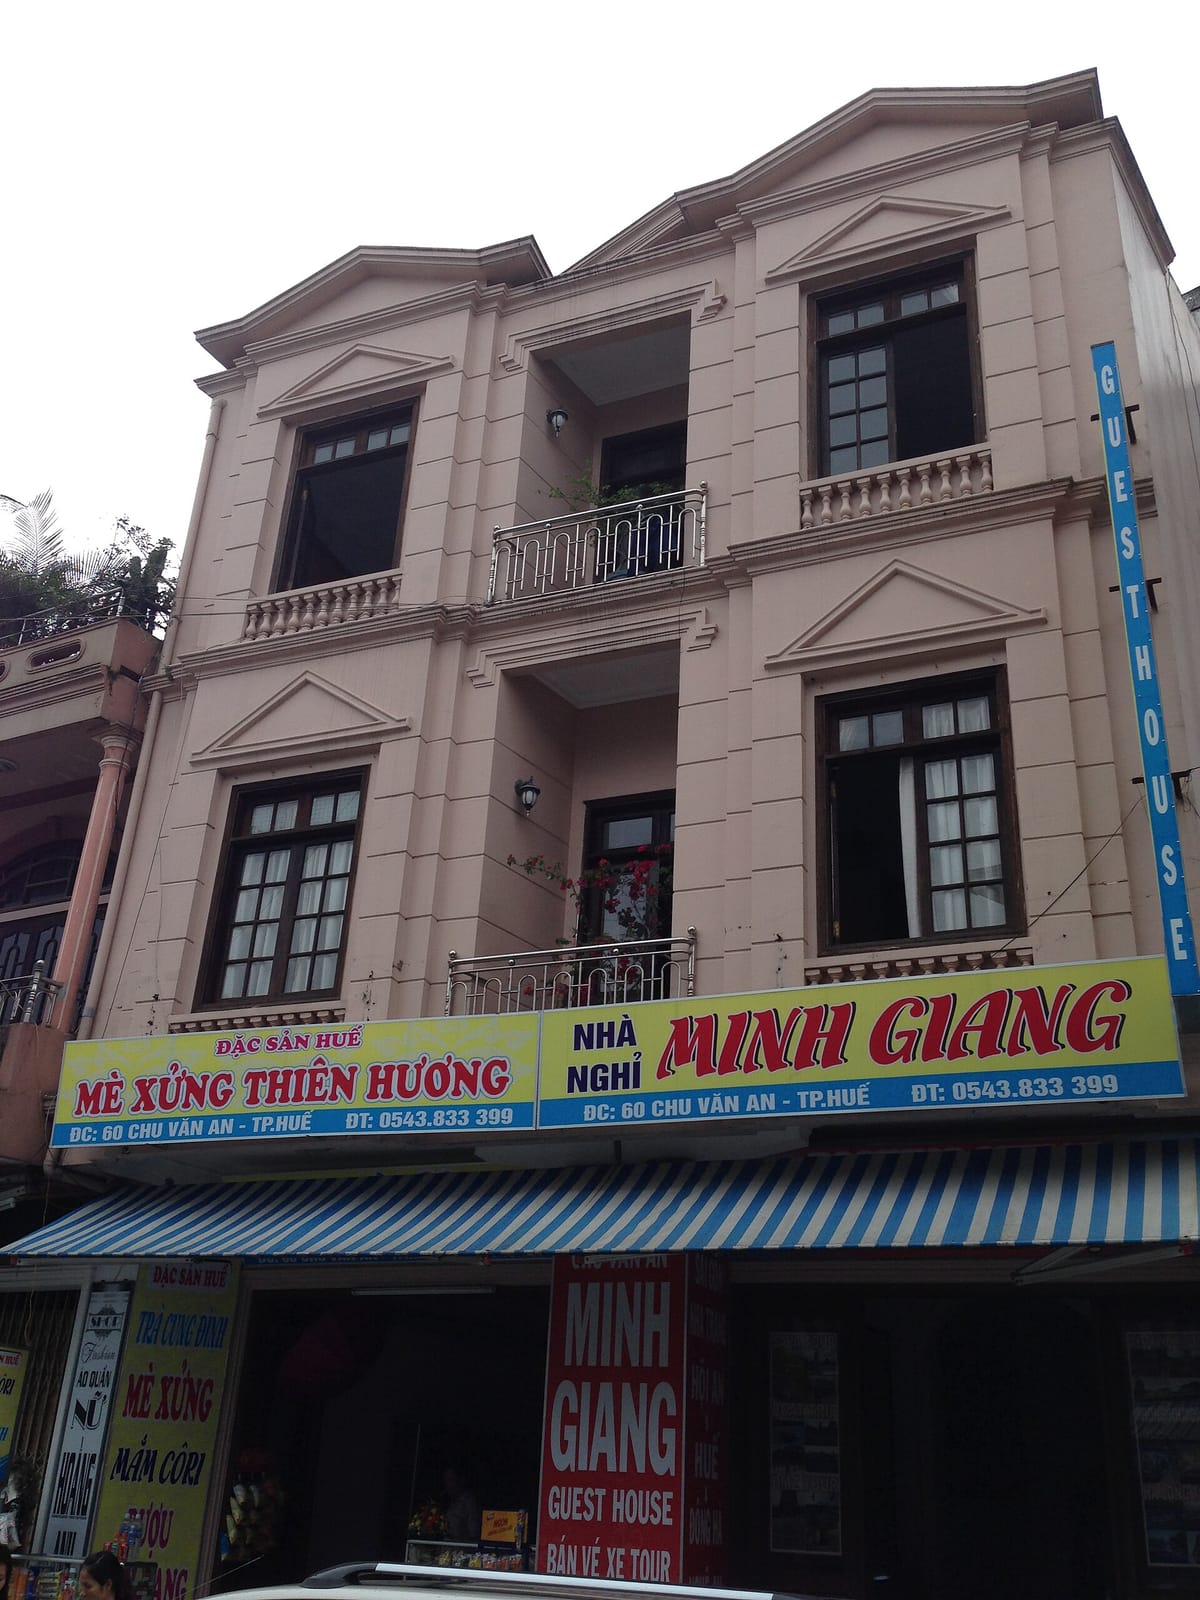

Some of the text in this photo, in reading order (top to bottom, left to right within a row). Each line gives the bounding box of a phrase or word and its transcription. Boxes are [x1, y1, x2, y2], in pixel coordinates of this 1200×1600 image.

[216, 1024, 364, 1059] ĐẶC SẢN HUẾ
[573, 1013, 638, 1051] NHÀ
[656, 979, 1132, 1080] MINH GIANG
[73, 1054, 511, 1117] MÈ XỬNG THIÊN HƯƠNG
[566, 1051, 642, 1094] NGHỈ
[583, 1103, 615, 1121] ĐC:
[621, 1101, 645, 1119] 60
[652, 1097, 691, 1117] CHU
[699, 1092, 740, 1114] VĂN
[745, 1093, 775, 1112] AN
[796, 1081, 872, 1109] TP.HUẾ
[911, 1083, 945, 1102] ĐT:
[952, 1078, 1064, 1100] 0543.833
[1071, 1074, 1119, 1095] 399
[69, 1127, 97, 1142] ĐC:
[102, 1125, 123, 1141] 60
[127, 1121, 163, 1139] CHU
[168, 1117, 204, 1137] VĂN
[208, 1119, 234, 1136] AN
[252, 1109, 315, 1133] TP.HUẾ
[345, 1112, 373, 1129] ĐT:
[379, 1109, 470, 1128] 0543.833
[475, 1108, 513, 1126] 399
[563, 1281, 671, 1367] MINH
[122, 1361, 156, 1419] MÈ
[550, 1379, 677, 1477] GIANG
[548, 1485, 674, 1526] GUEST HOUSE
[546, 1534, 577, 1575] BÁN
[582, 1537, 601, 1577] VÉ
[606, 1546, 626, 1579] XE
[630, 1548, 671, 1582] TOUR
